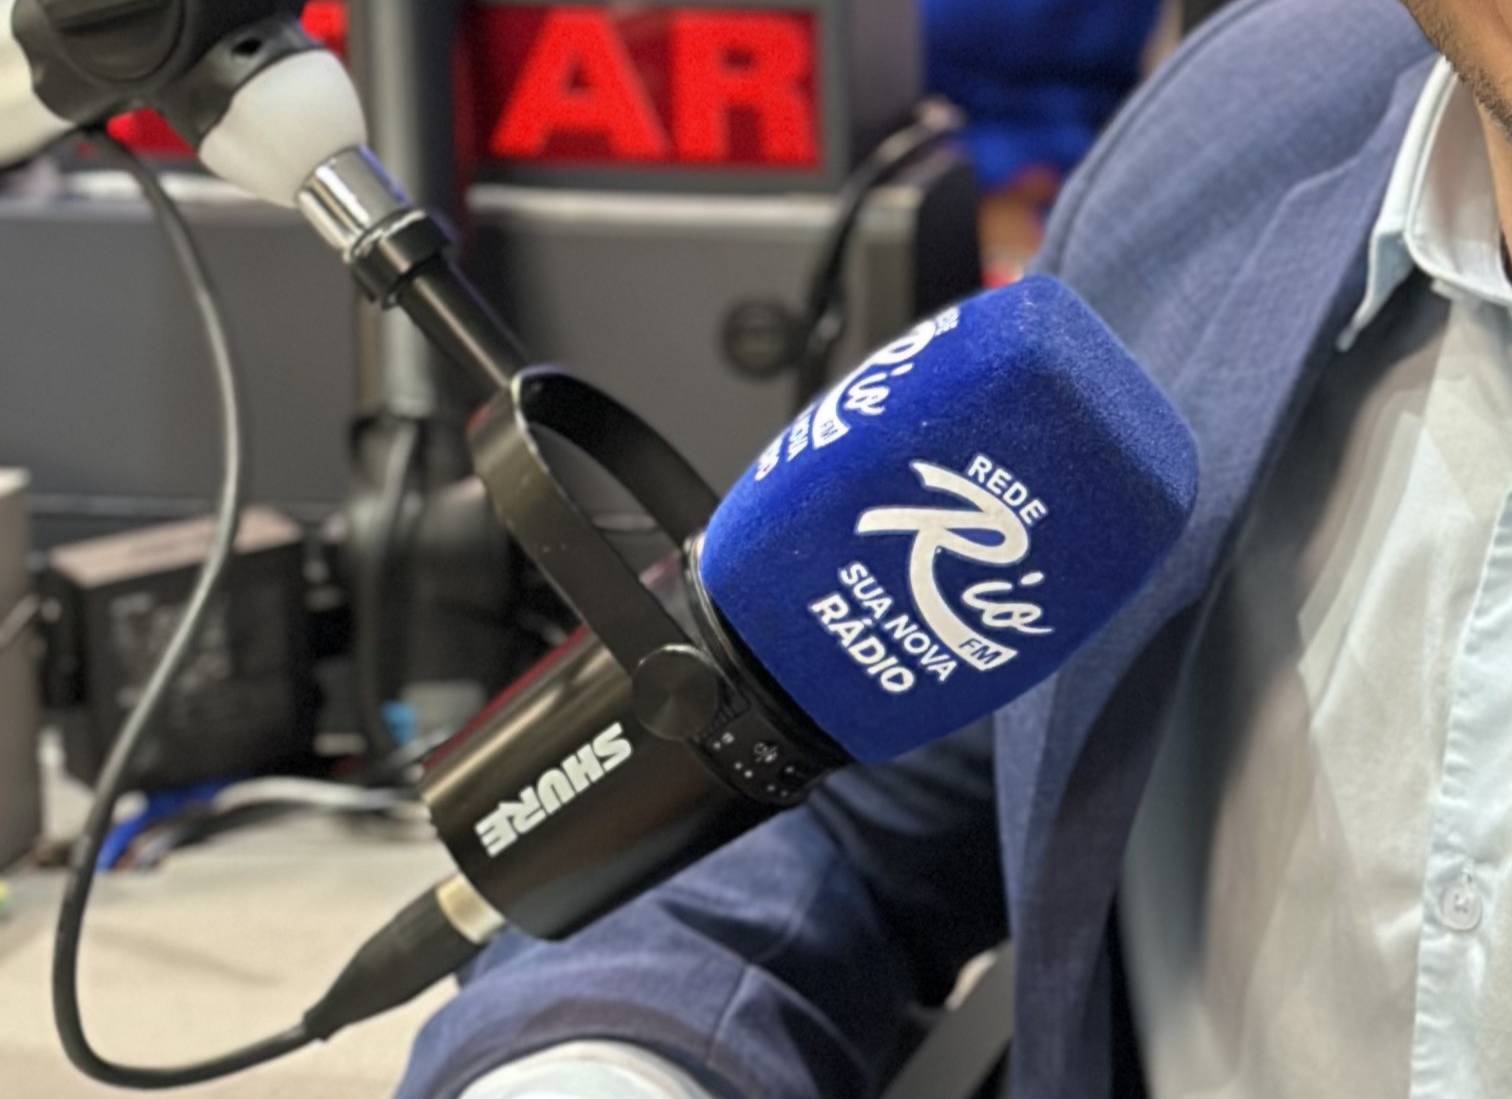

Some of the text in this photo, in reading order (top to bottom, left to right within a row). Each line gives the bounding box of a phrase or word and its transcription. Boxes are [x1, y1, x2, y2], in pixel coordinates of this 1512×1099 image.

[490, 8, 818, 163] AR
[967, 455, 1048, 526] REDE
[838, 562, 958, 682] SUA NOVA
[856, 460, 1054, 671] Rio
[809, 593, 915, 693] RÁDIO
[958, 637, 1004, 666] FM
[474, 721, 633, 858] SHURE
